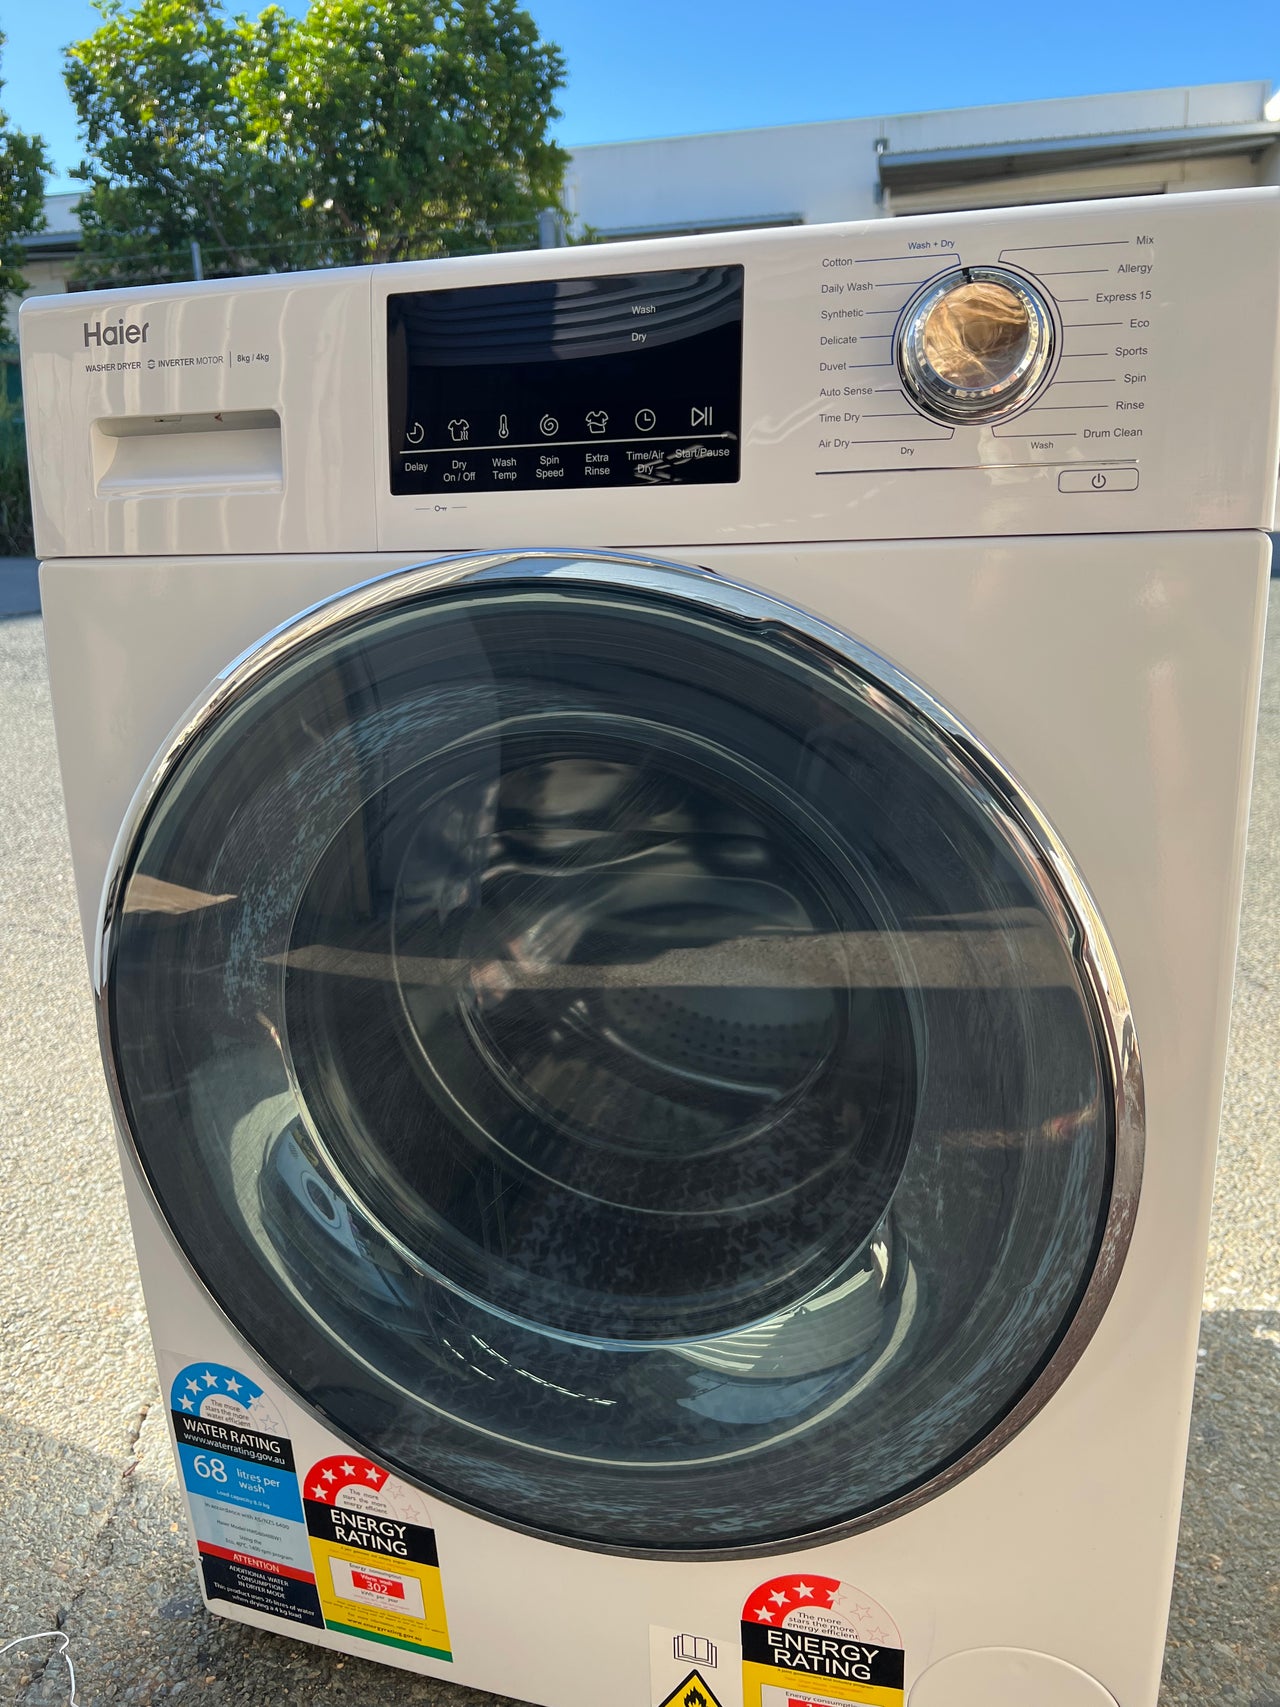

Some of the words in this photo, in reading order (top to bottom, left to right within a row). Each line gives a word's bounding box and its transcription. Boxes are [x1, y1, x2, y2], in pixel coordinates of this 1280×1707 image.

[908, 240, 931, 250] Wash
[940, 239, 956, 250] Dry
[1136, 235, 1154, 245] Mix
[822, 257, 853, 268] Cotton
[1117, 263, 1153, 275] Allergy
[821, 284, 849, 295] Daily
[850, 281, 873, 292] Wash
[1096, 292, 1138, 304] Express
[1140, 290, 1152, 300] 15
[631, 304, 656, 315] Wash
[820, 308, 864, 320] Synthetic
[1130, 319, 1150, 329] Eco
[83, 318, 150, 347] Haier
[631, 332, 647, 343] Dry
[820, 335, 858, 345] Delicate
[237, 354, 251, 364] 8kg
[256, 353, 270, 363] 4kg
[1115, 347, 1148, 358] Sports
[85, 363, 117, 373] WASHER
[117, 361, 142, 371] DRYER
[158, 358, 195, 368] INVERTER
[196, 355, 224, 365] MOTOR
[819, 362, 847, 372] Duvet
[1123, 373, 1147, 384] Spin
[819, 388, 843, 397] Auto
[845, 386, 873, 396] Sense
[1115, 400, 1145, 411] Rinse
[819, 413, 841, 423] Time
[842, 413, 861, 424] Dry
[1083, 428, 1112, 439] Drum
[1113, 427, 1143, 438] Clean
[818, 439, 833, 449] Air
[834, 438, 850, 450] Dry
[1031, 441, 1054, 450] Wash
[585, 453, 609, 463] Extra
[626, 450, 664, 461] Time/Air
[675, 447, 730, 459] Start/Pause
[900, 447, 915, 457] Dry
[452, 460, 467, 471] Dry
[492, 458, 517, 467] Wash
[539, 455, 560, 465] Spin
[404, 462, 429, 473] Delay
[536, 468, 564, 479] Speed
[584, 466, 610, 476] Rinse
[637, 463, 654, 475] Dry
[443, 472, 456, 482] On
[463, 472, 476, 481] Off
[492, 470, 517, 480] Temp
[210, 1399, 223, 1408] The
[223, 1403, 241, 1412] more
[205, 1405, 220, 1414] stars
[220, 1408, 231, 1417] the
[232, 1411, 249, 1421] more
[206, 1412, 224, 1421] water
[225, 1416, 251, 1428] efficient
[182, 1417, 229, 1440] WATER
[230, 1430, 281, 1454] RATING
[183, 1432, 286, 1465] www.waterrating.gov.au
[193, 1454, 228, 1483] 68
[236, 1467, 262, 1483] litres
[263, 1476, 281, 1488] per
[238, 1481, 265, 1494] wash
[230, 1493, 252, 1505] capacity
[263, 1502, 271, 1510] kg
[363, 1492, 379, 1500] more
[211, 1504, 241, 1516] accordance
[343, 1500, 363, 1510] energy
[365, 1505, 388, 1515] efficient
[330, 1509, 406, 1539] ENERGY
[335, 1525, 408, 1556] RATING
[233, 1553, 280, 1573] ATTENTION
[349, 1563, 367, 1572] Energy
[229, 1565, 266, 1580] ADDITIONAL
[267, 1576, 289, 1587] WATER
[360, 1573, 378, 1583] Warm
[379, 1578, 393, 1587] wash
[236, 1573, 284, 1592] CONSUMPTION
[366, 1582, 388, 1595] 302
[245, 1582, 266, 1594] DRYER
[266, 1589, 286, 1600] MODE
[213, 1582, 226, 1590] This
[227, 1587, 250, 1598] product
[251, 1594, 265, 1602] uses
[273, 1600, 289, 1609] litres
[296, 1607, 315, 1616] water
[232, 1594, 249, 1603] when
[249, 1599, 269, 1611] drying
[279, 1608, 288, 1616] kg
[288, 1610, 303, 1619] load
[797, 1611, 816, 1621] The
[817, 1615, 842, 1625] more
[787, 1622, 820, 1633] energy
[821, 1627, 860, 1640] efficient
[788, 1617, 811, 1626] stars
[812, 1620, 828, 1628] the
[829, 1625, 855, 1634] more
[767, 1629, 880, 1664] ENERGY
[773, 1648, 872, 1680] RATING
[785, 1691, 812, 1701] Energy
